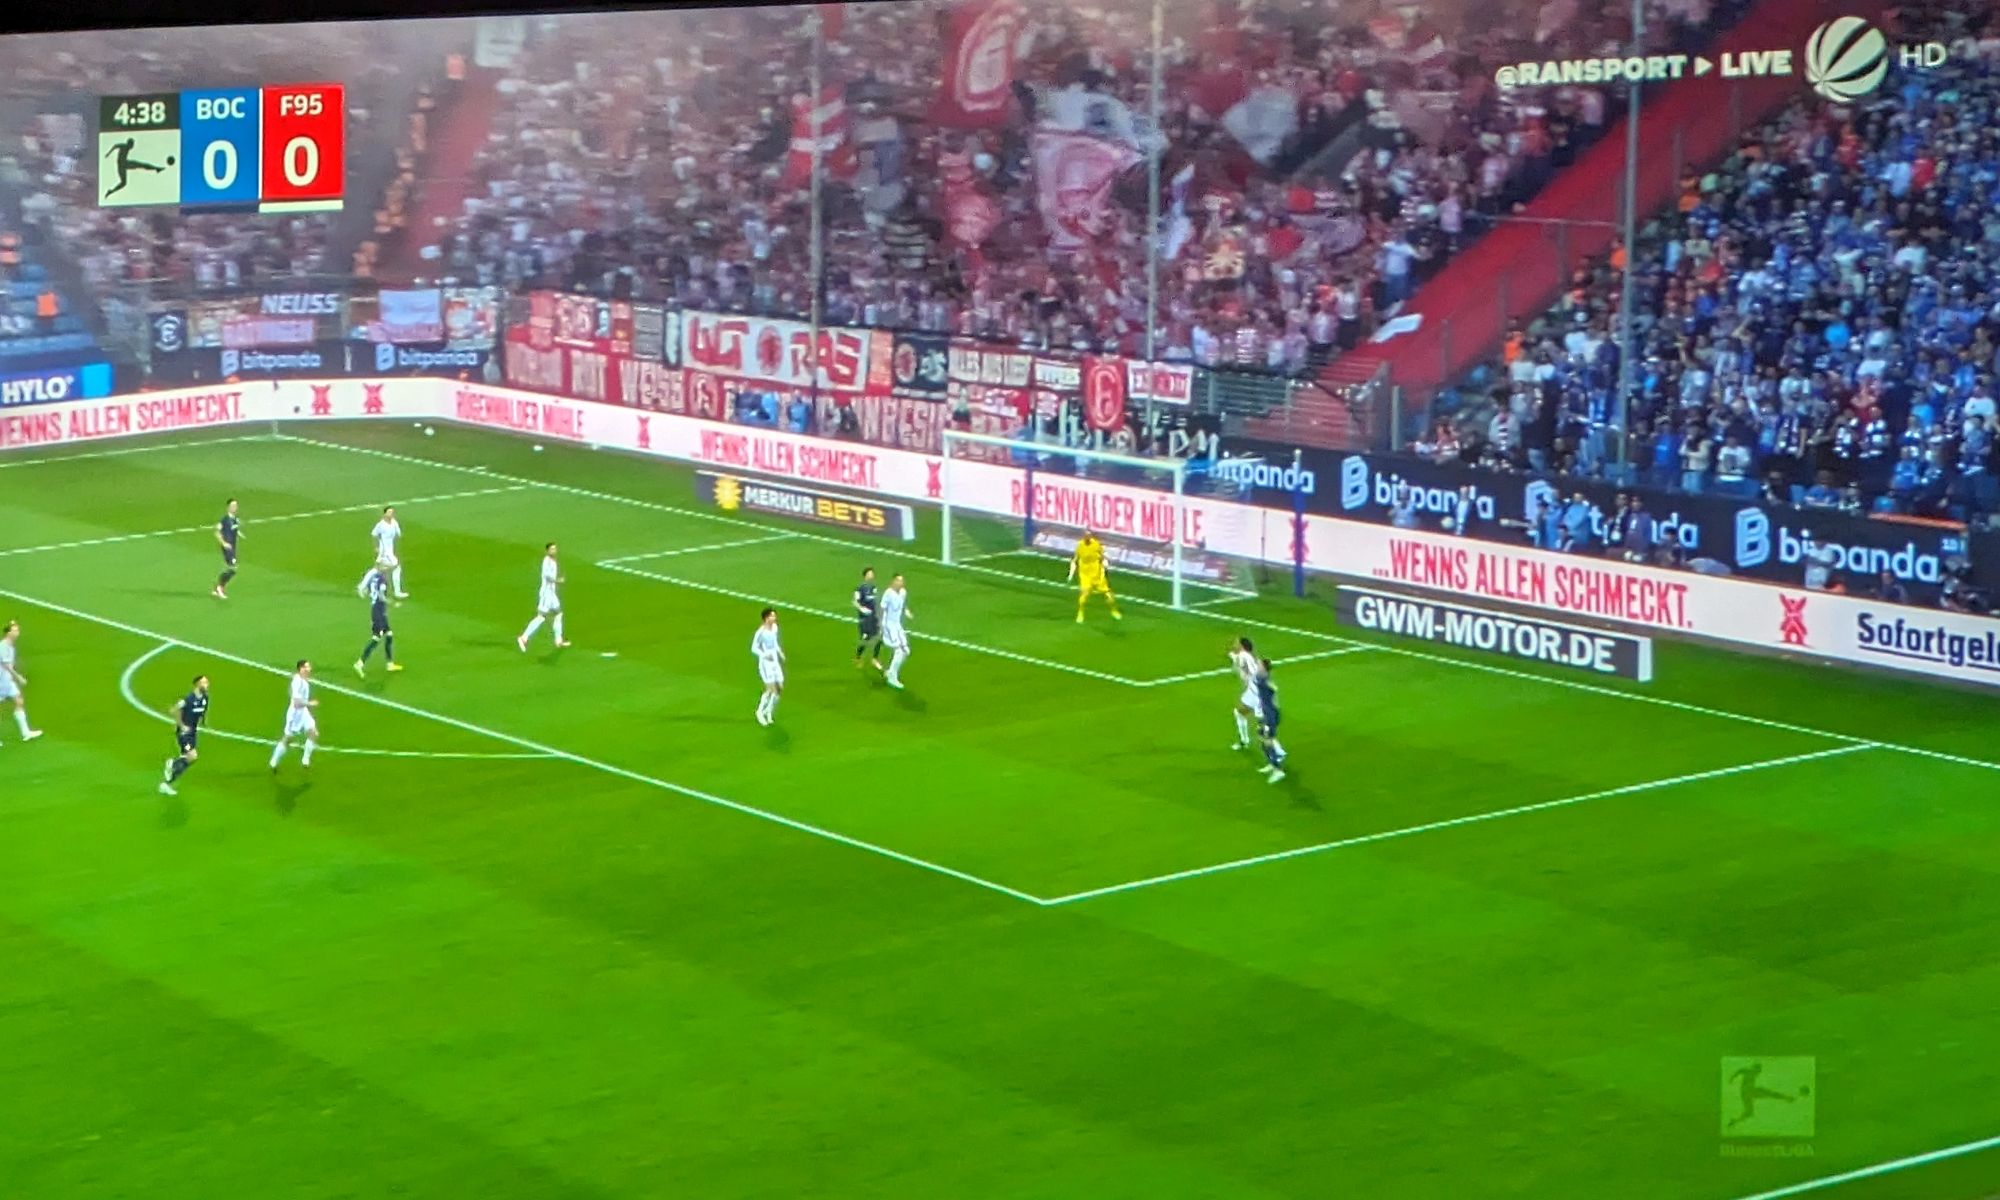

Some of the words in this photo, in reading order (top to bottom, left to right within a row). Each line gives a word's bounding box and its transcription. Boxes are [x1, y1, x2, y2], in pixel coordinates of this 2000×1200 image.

[1496, 54, 1687, 87] @RANSPORT
[1721, 50, 1792, 77] LIVE
[1901, 43, 1947, 68] HD
[113, 102, 166, 125] 4:38
[196, 97, 246, 120] BOC
[279, 94, 323, 116] F95
[203, 139, 238, 190] 0
[283, 136, 319, 187] 0
[261, 293, 339, 314] NEUSS
[242, 350, 322, 373] bitpanda
[400, 348, 479, 371] bitpanda
[2, 376, 68, 404] HYLO
[68, 403, 131, 438] ALLEN
[137, 391, 246, 431] SCHMECKT.
[754, 437, 794, 474] ALLEN
[744, 485, 815, 515] MERKUR
[817, 497, 885, 528] BETS
[1475, 553, 1546, 604] ALLEN
[1554, 565, 1694, 629] SCHMECKT.
[1355, 595, 1617, 673] GWM-MOTOR.DE
[1857, 611, 2000, 668] Sofortgel
